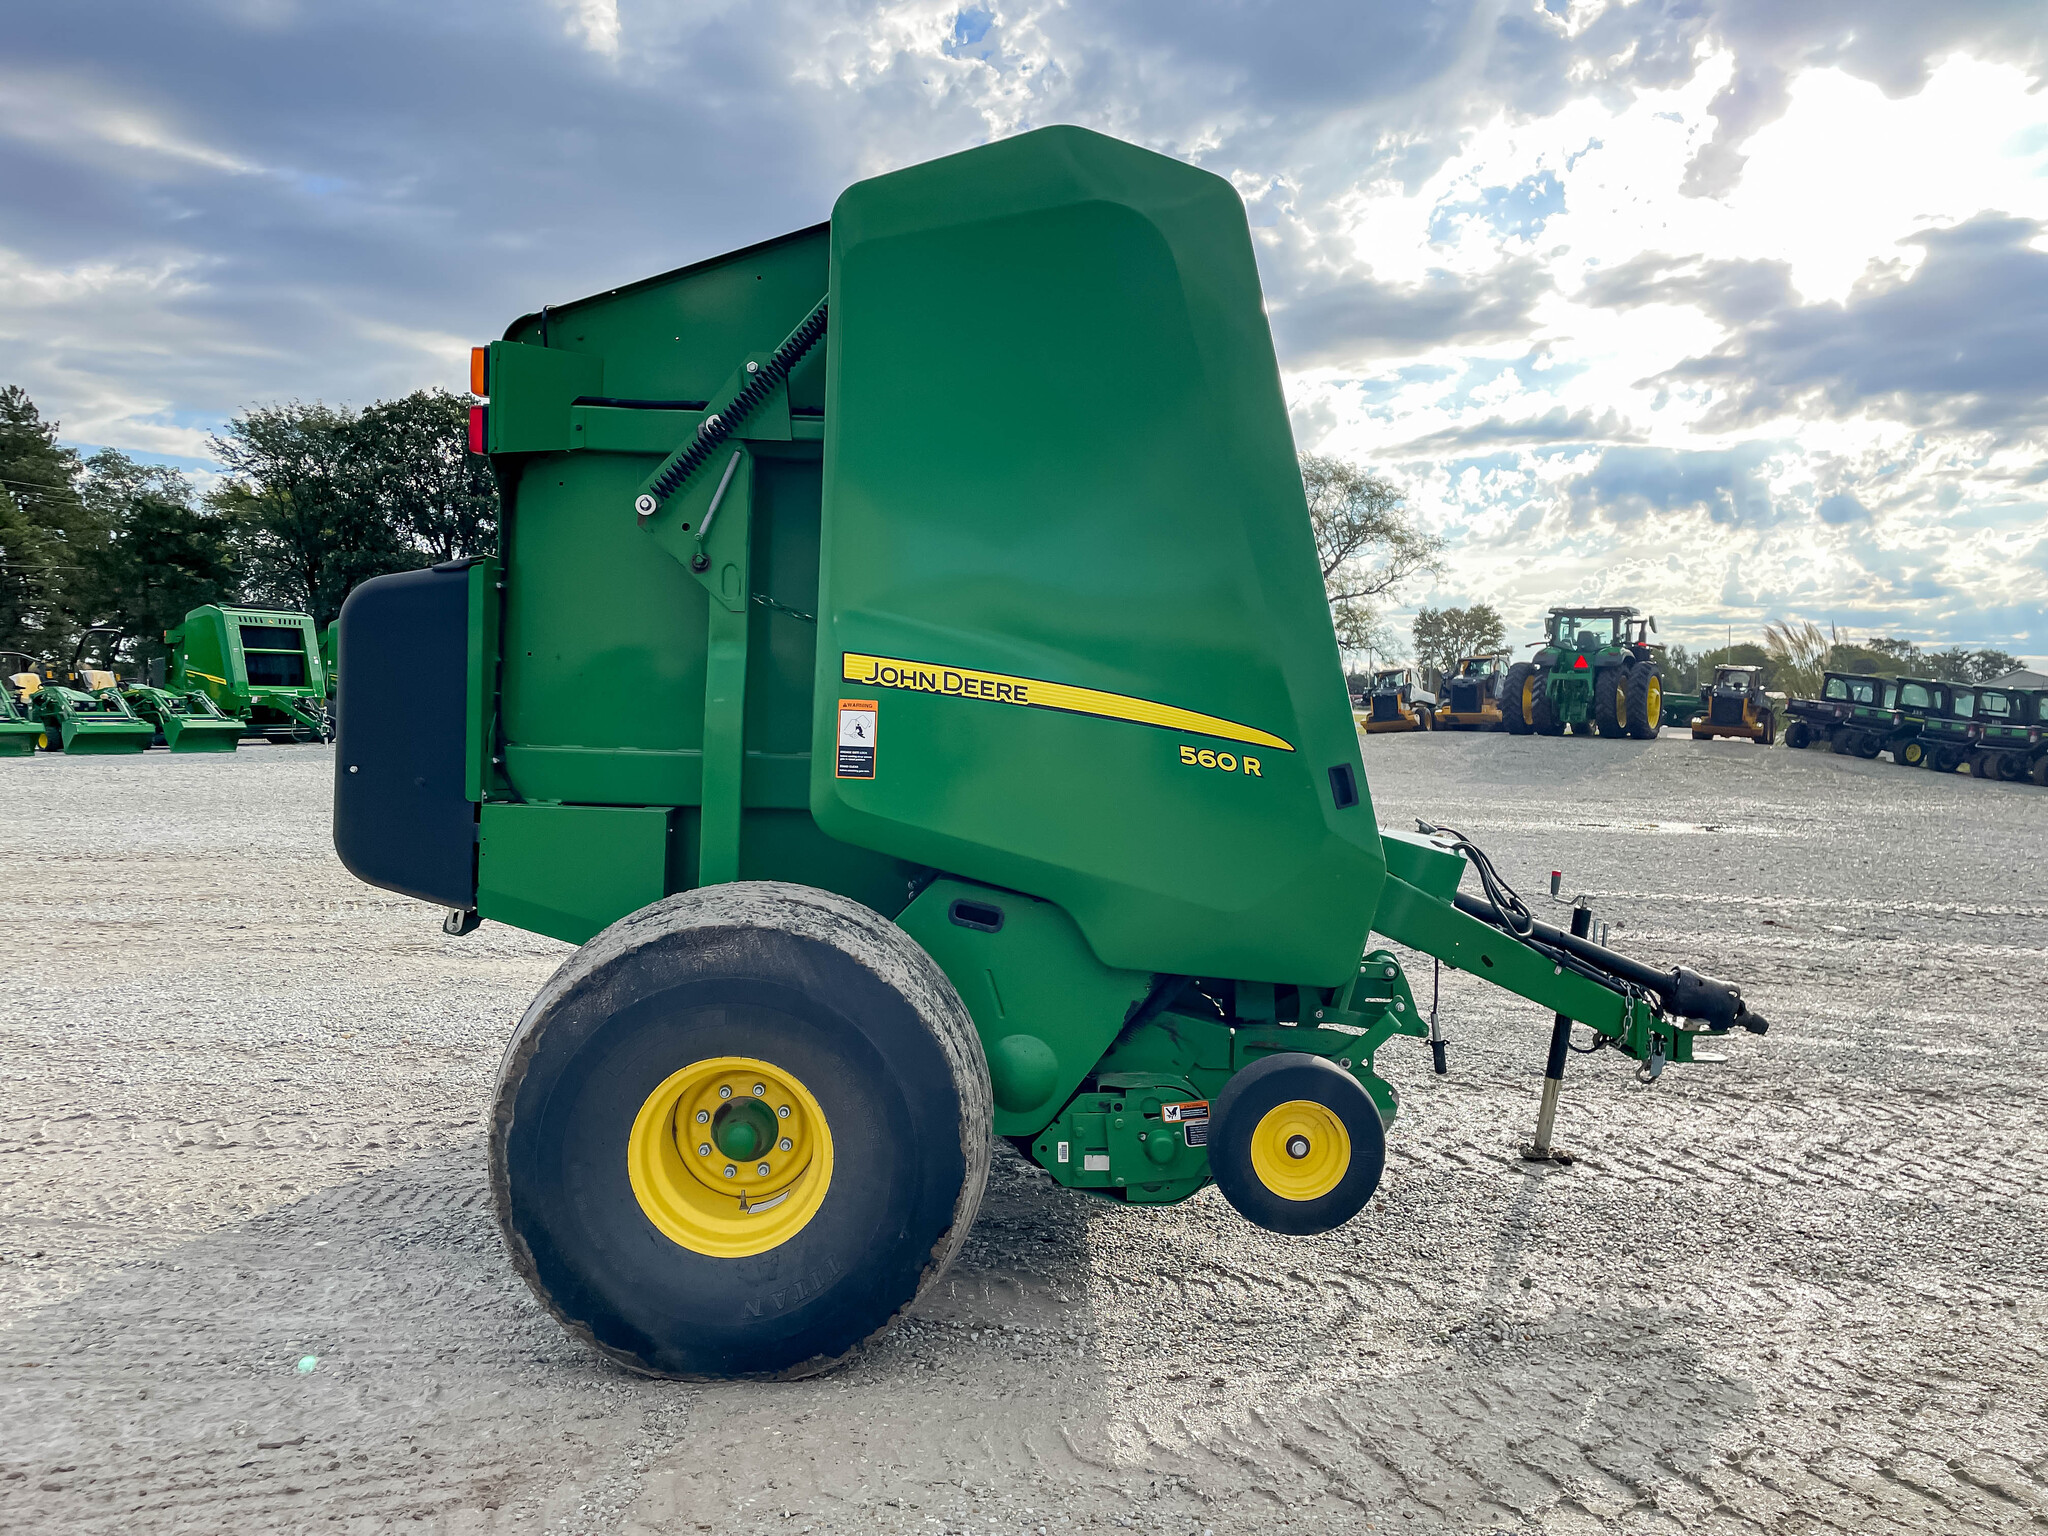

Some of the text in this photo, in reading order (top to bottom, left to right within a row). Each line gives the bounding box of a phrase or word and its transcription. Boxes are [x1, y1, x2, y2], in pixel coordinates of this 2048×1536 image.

[864, 662, 1029, 703] JOHN DEERE
[1179, 745, 1262, 777] 560 R
[744, 1254, 844, 1320] TITAN
